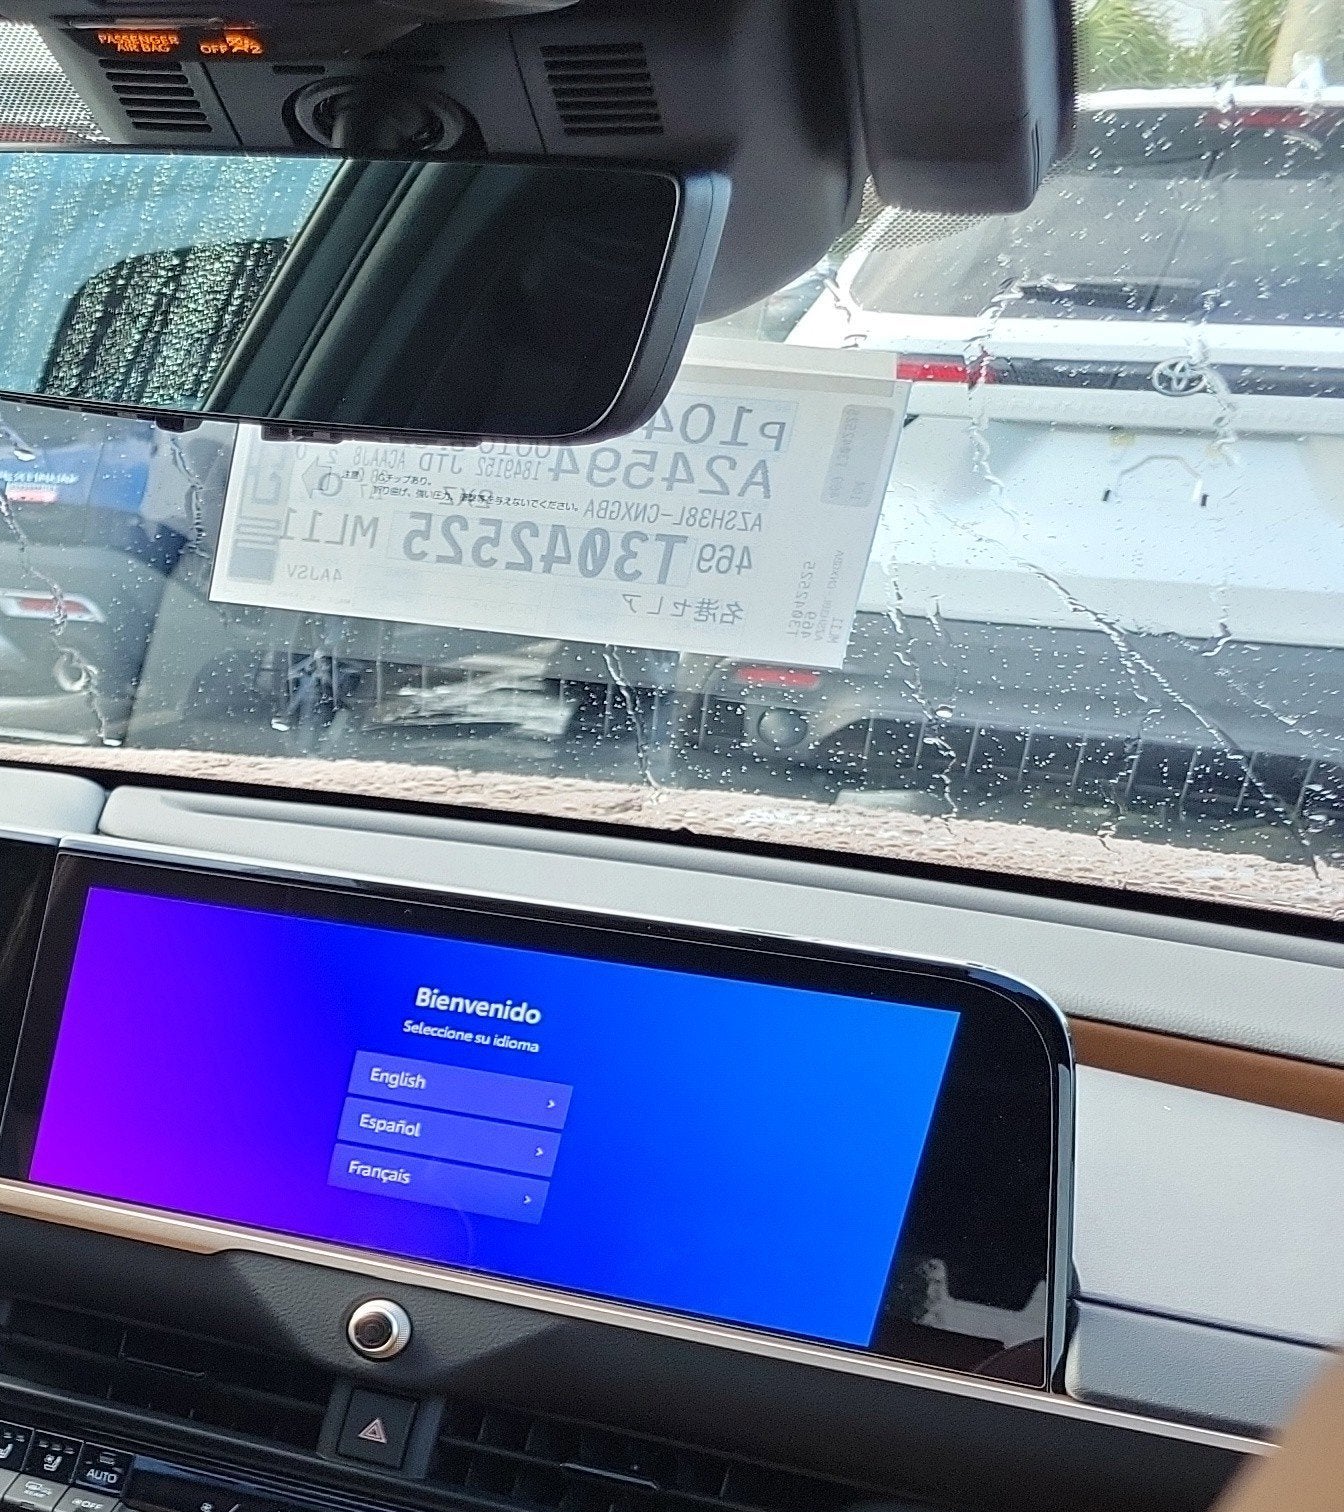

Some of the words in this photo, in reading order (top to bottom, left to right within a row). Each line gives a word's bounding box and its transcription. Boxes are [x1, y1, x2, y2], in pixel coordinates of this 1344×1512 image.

[98, 33, 180, 45] PASSENGER
[199, 44, 228, 54] OFF
[415, 986, 542, 1025] Bienvenido
[403, 1019, 474, 1043] Seleccione
[474, 1034, 491, 1045] su
[492, 1034, 540, 1053] idioma
[370, 1067, 427, 1089] English
[359, 1113, 422, 1138] Español
[348, 1160, 411, 1184] Français
[86, 1468, 118, 1484] AUTO
[80, 1500, 104, 1510] OFF
